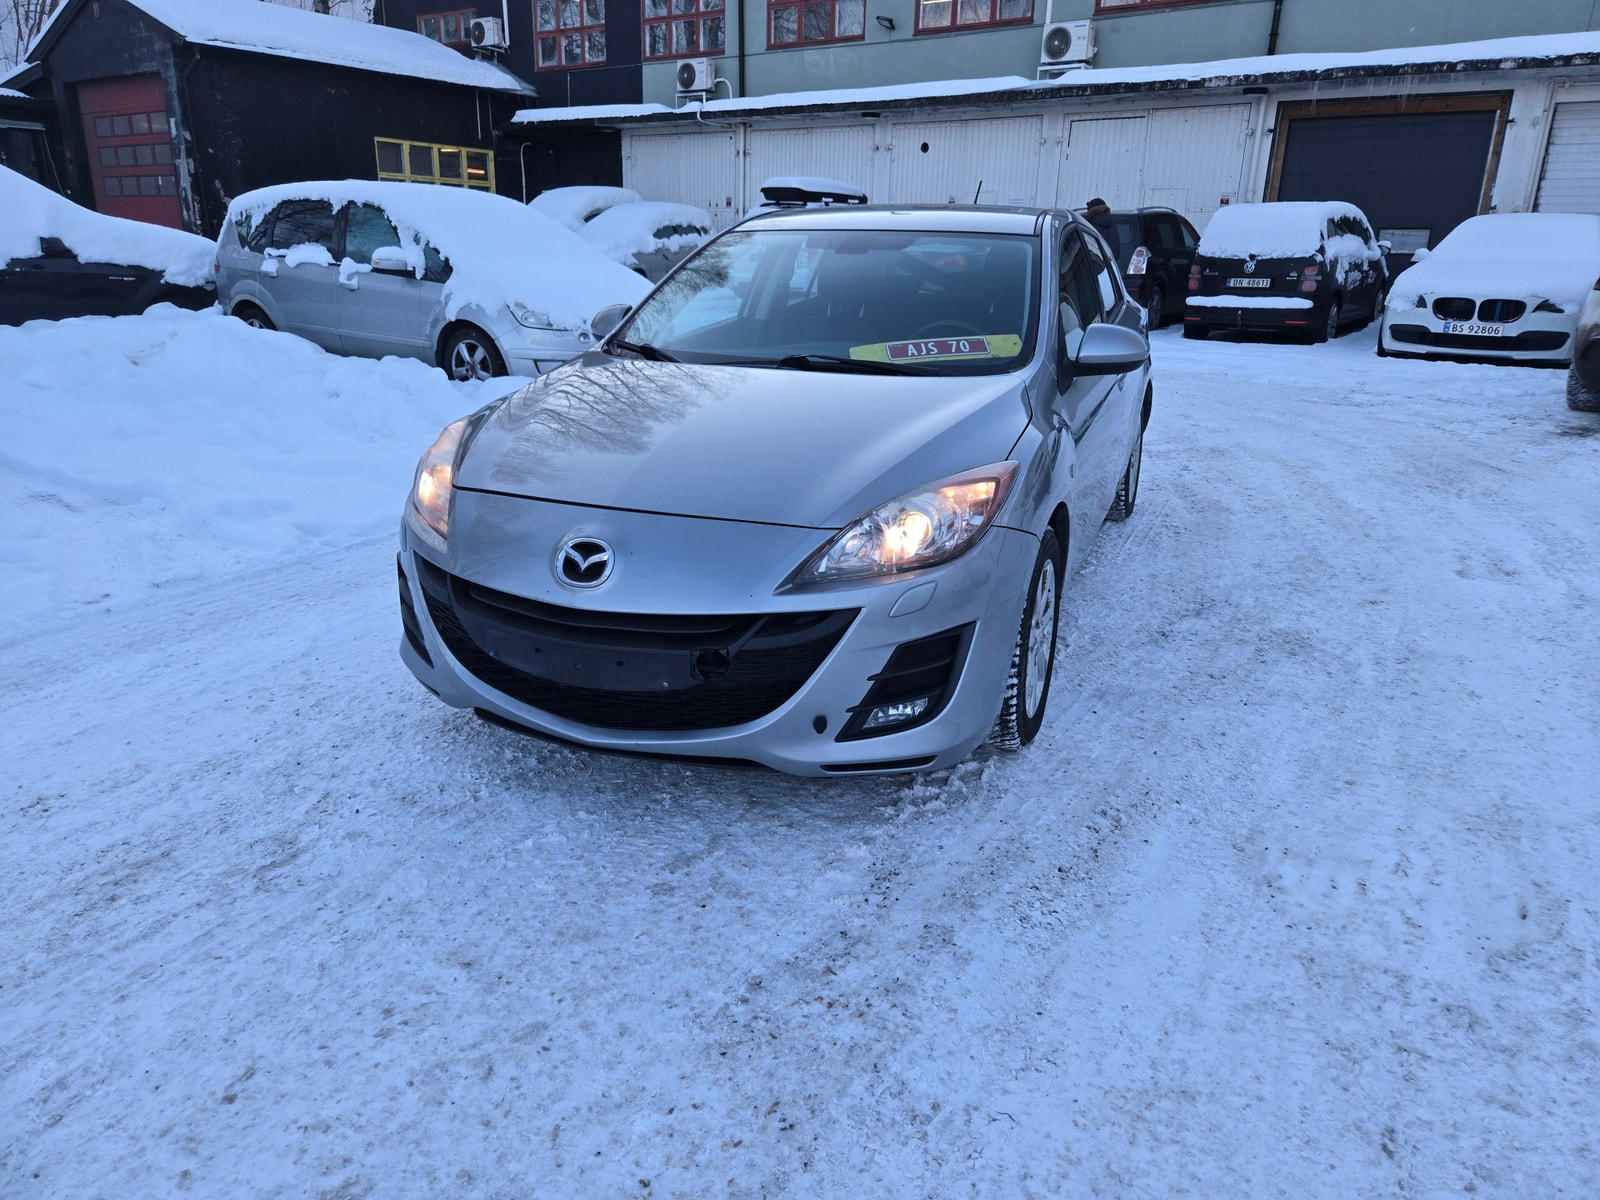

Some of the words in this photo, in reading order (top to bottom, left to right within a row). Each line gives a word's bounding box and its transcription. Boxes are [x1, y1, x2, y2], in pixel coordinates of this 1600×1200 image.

[1246, 279, 1270, 287] 48613
[1451, 323, 1464, 333] BS
[1468, 324, 1500, 335] 92806
[908, 341, 938, 357] AJS
[948, 340, 970, 353] 70
